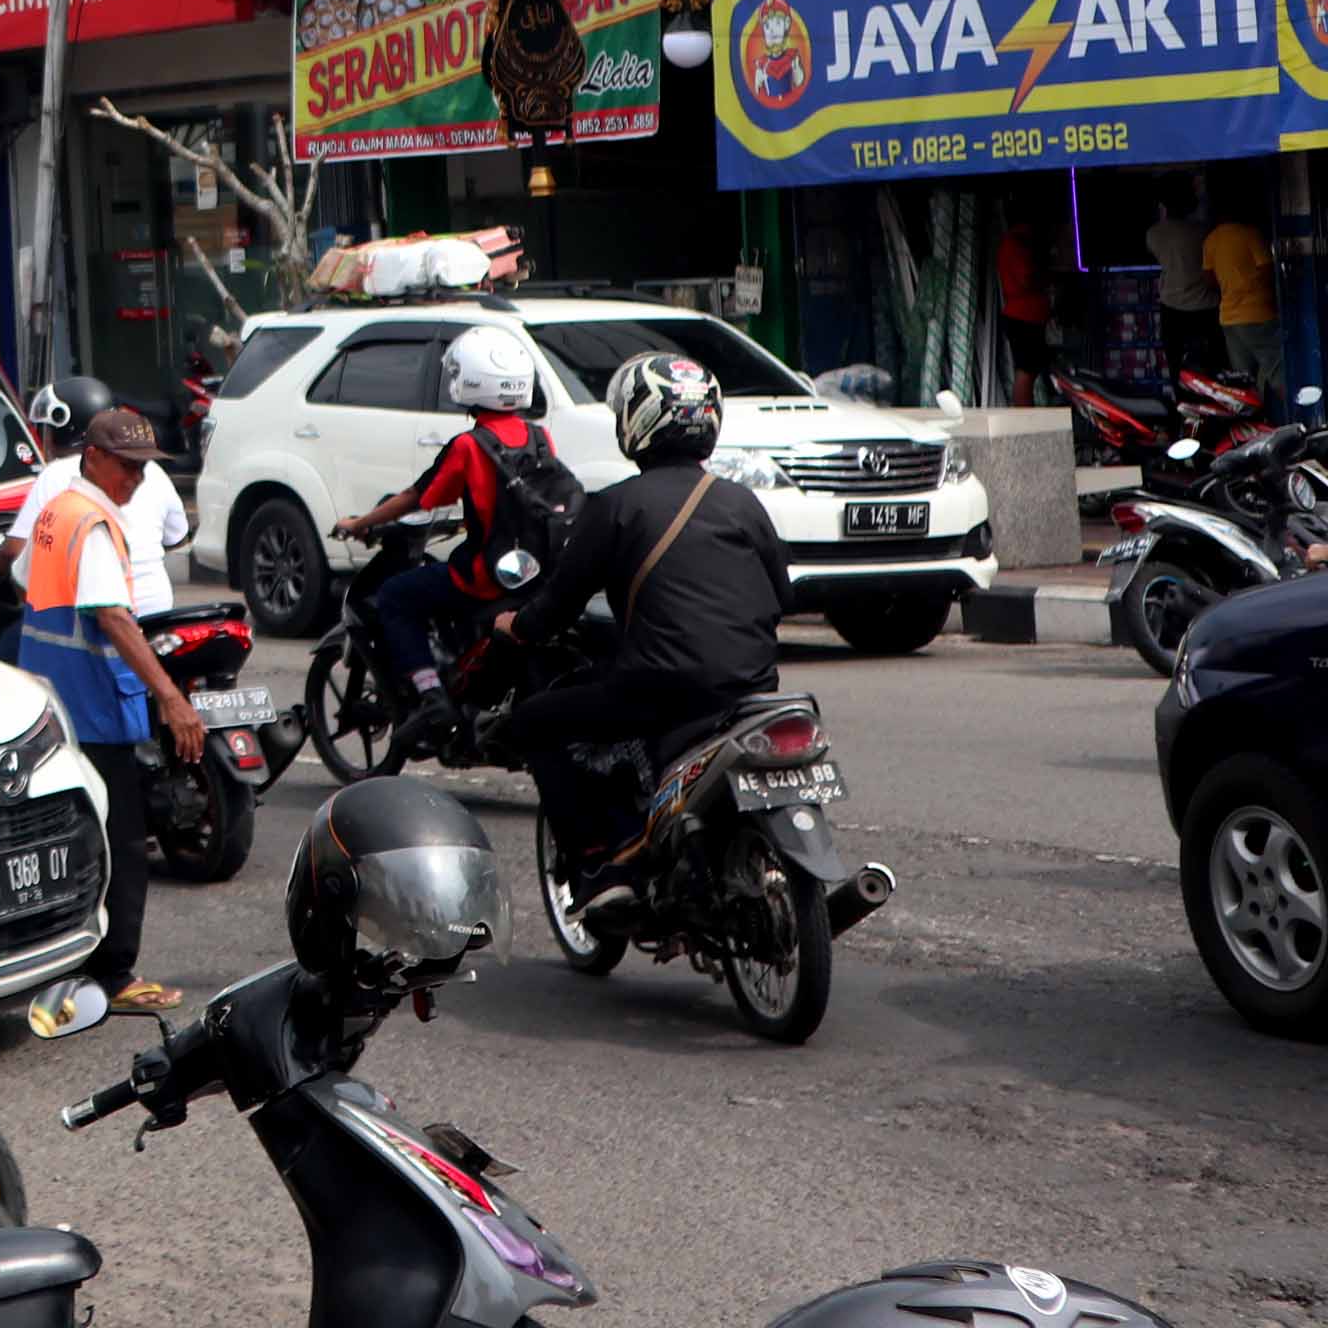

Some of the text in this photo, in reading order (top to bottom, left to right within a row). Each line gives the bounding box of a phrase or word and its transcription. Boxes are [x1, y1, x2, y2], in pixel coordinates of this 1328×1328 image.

[307, 23, 416, 119] SERABI
[579, 50, 654, 96] Lidia
[351, 137, 382, 153] GAJAH
[383, 135, 415, 151] MADA
[991, 128, 1042, 159] 2920
[1063, 122, 1130, 153] 9662
[851, 505, 925, 526] K 1415 MF
[737, 772, 760, 793] AE
[811, 762, 837, 783] BB
[7, 852, 41, 892] 1368
[49, 846, 69, 881] OY
